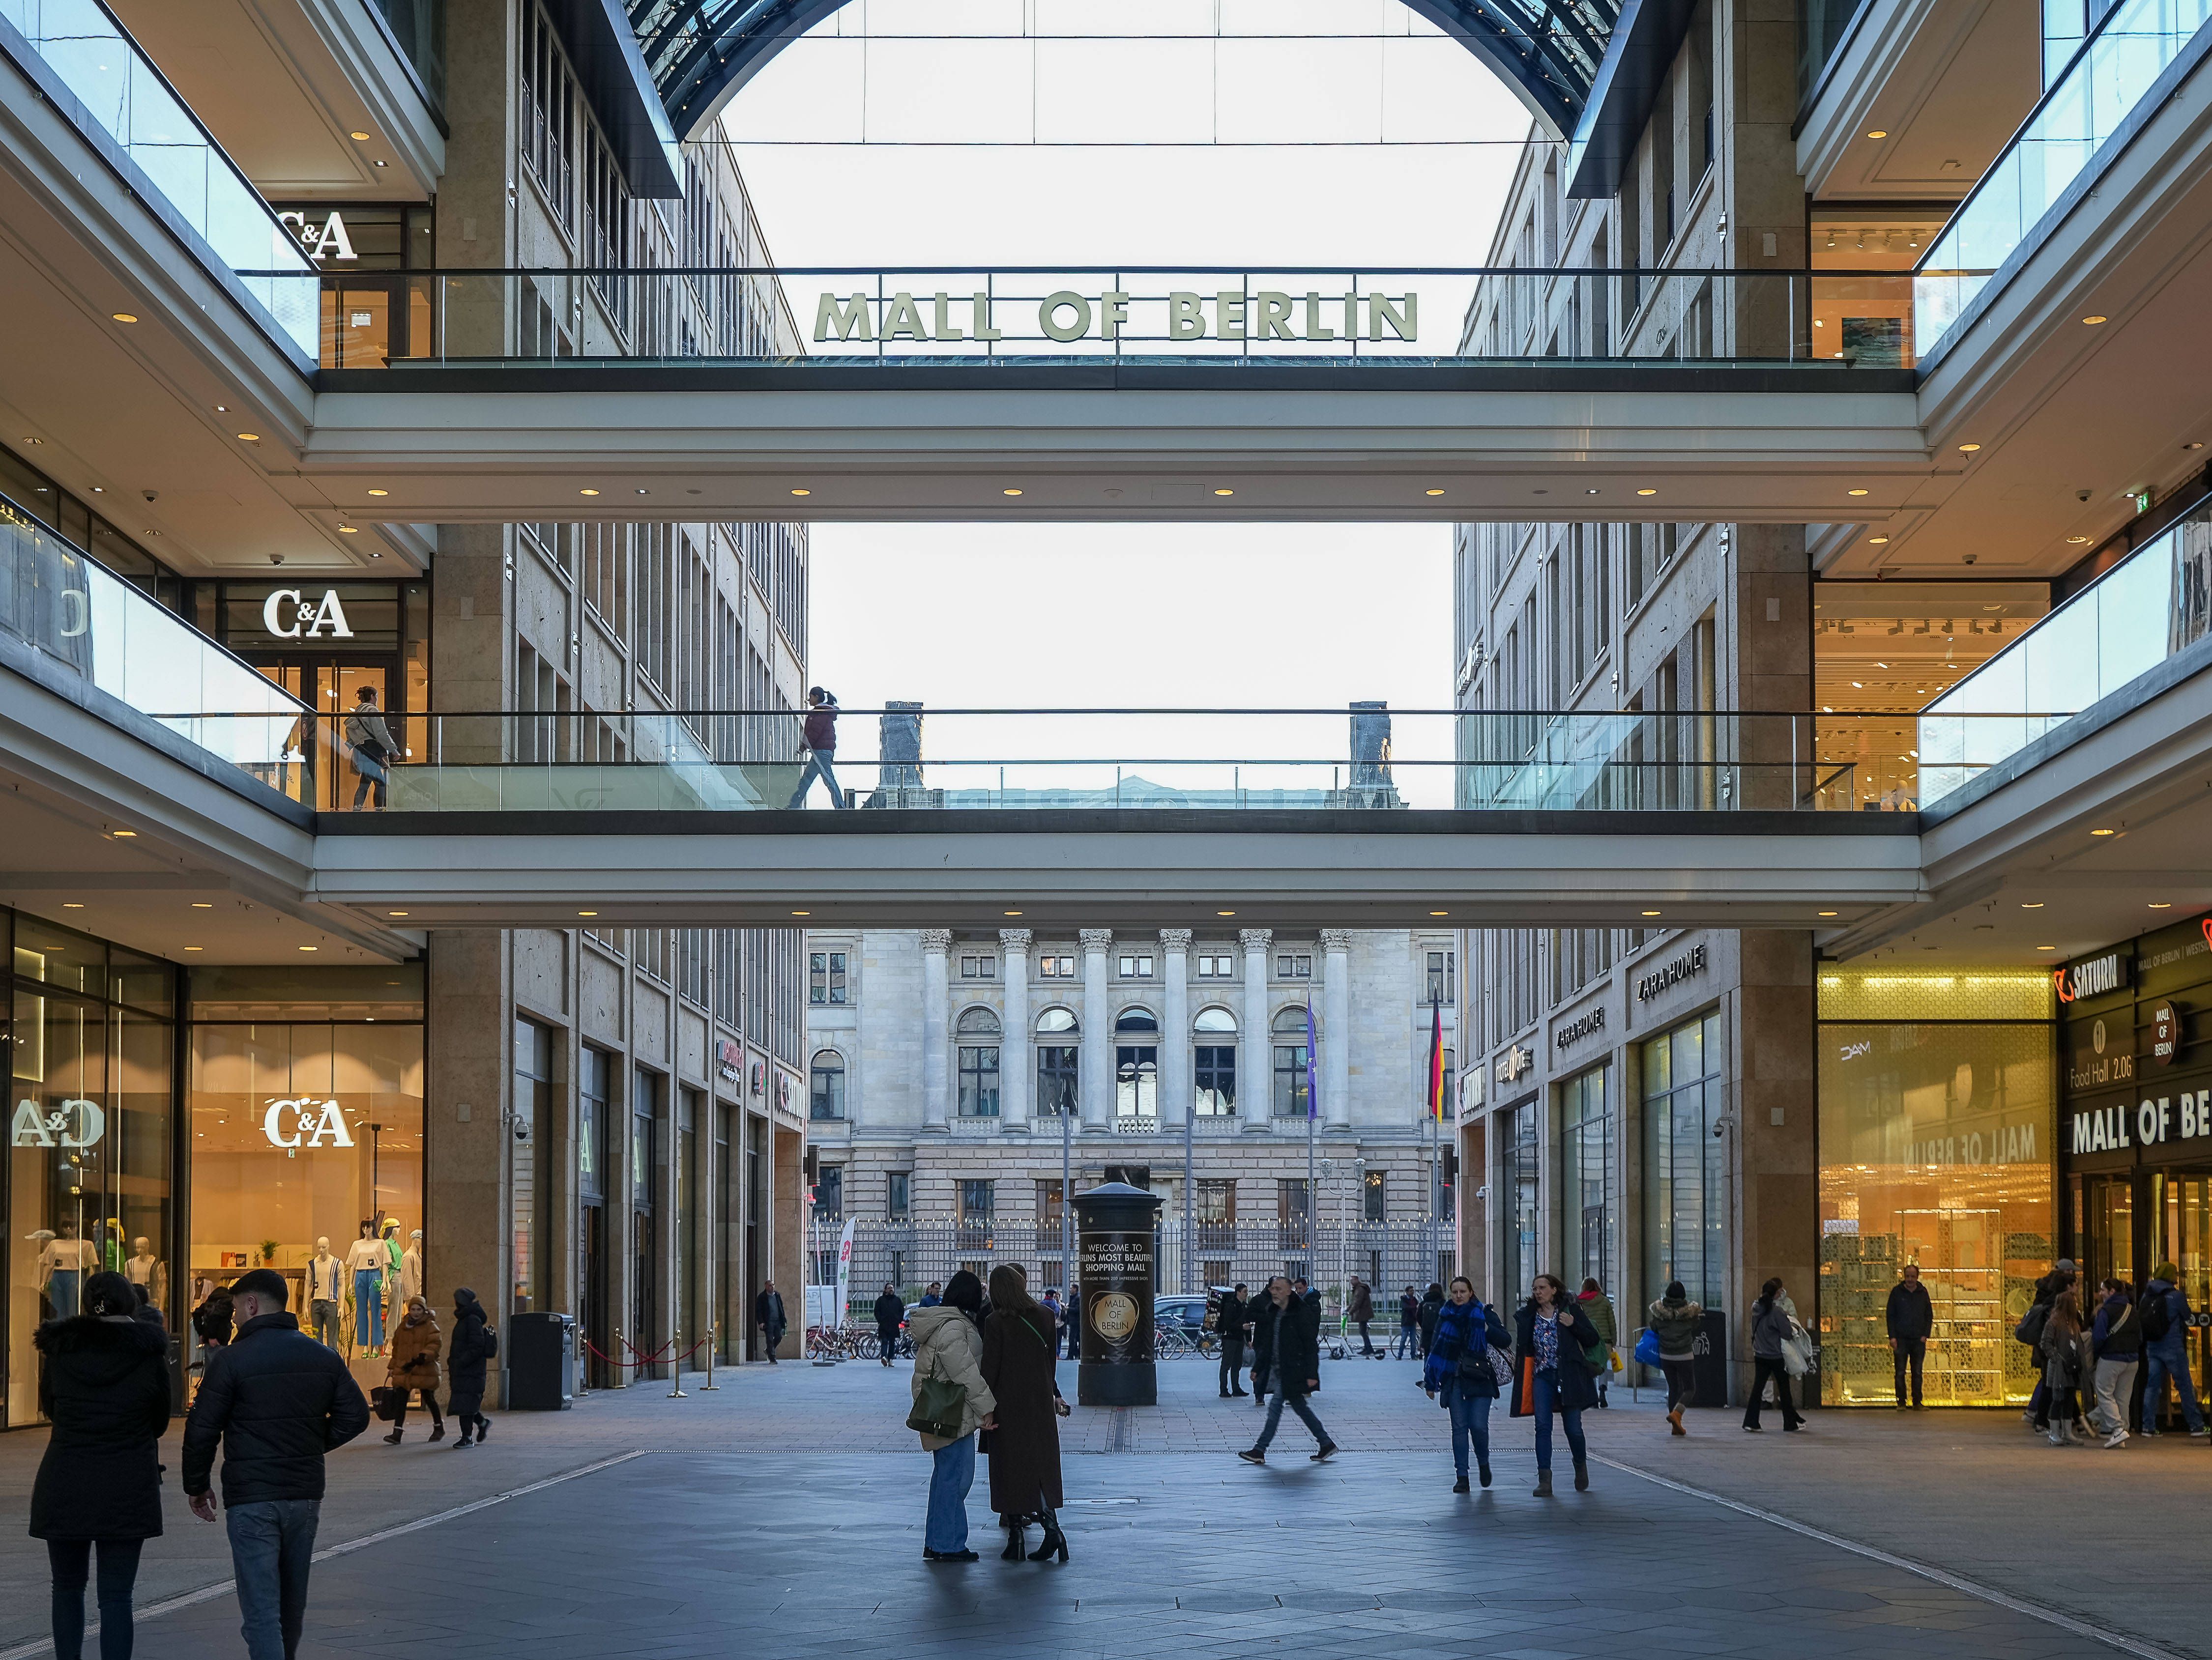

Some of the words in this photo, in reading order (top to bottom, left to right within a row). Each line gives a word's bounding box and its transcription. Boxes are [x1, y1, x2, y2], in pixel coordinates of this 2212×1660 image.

[814, 292, 1001, 342] MALL
[1039, 290, 1129, 343] OF
[1169, 292, 1417, 342] BERLIN
[263, 589, 354, 638] C&A
[1636, 968, 1665, 1002] ZARA
[1669, 944, 1703, 984] HOME
[2138, 957, 2153, 972] MALL
[2153, 955, 2161, 967] OF
[2162, 948, 2180, 964] BERLIN
[2073, 954, 2118, 999] SATURN
[1556, 1023, 1576, 1050] ZARA
[1577, 1007, 1601, 1037] HOME
[2156, 1007, 2170, 1023] MALL
[2158, 1025, 2167, 1038] OF
[2154, 1041, 2172, 1057] BERLIN
[2070, 1063, 2090, 1089] Food
[2093, 1059, 2109, 1084] Hall
[264, 1099, 354, 1148] C&A
[2072, 1105, 2130, 1155] MALL
[2138, 1096, 2170, 1146] OF
[1088, 1244, 1129, 1252] WELCOME
[1132, 1244, 1142, 1252] TO
[1085, 1263, 1125, 1272] SHOPPING
[1127, 1263, 1146, 1272] MALL
[1104, 1299, 1126, 1308] MALL
[1102, 1321, 1129, 1330] BERLIN
